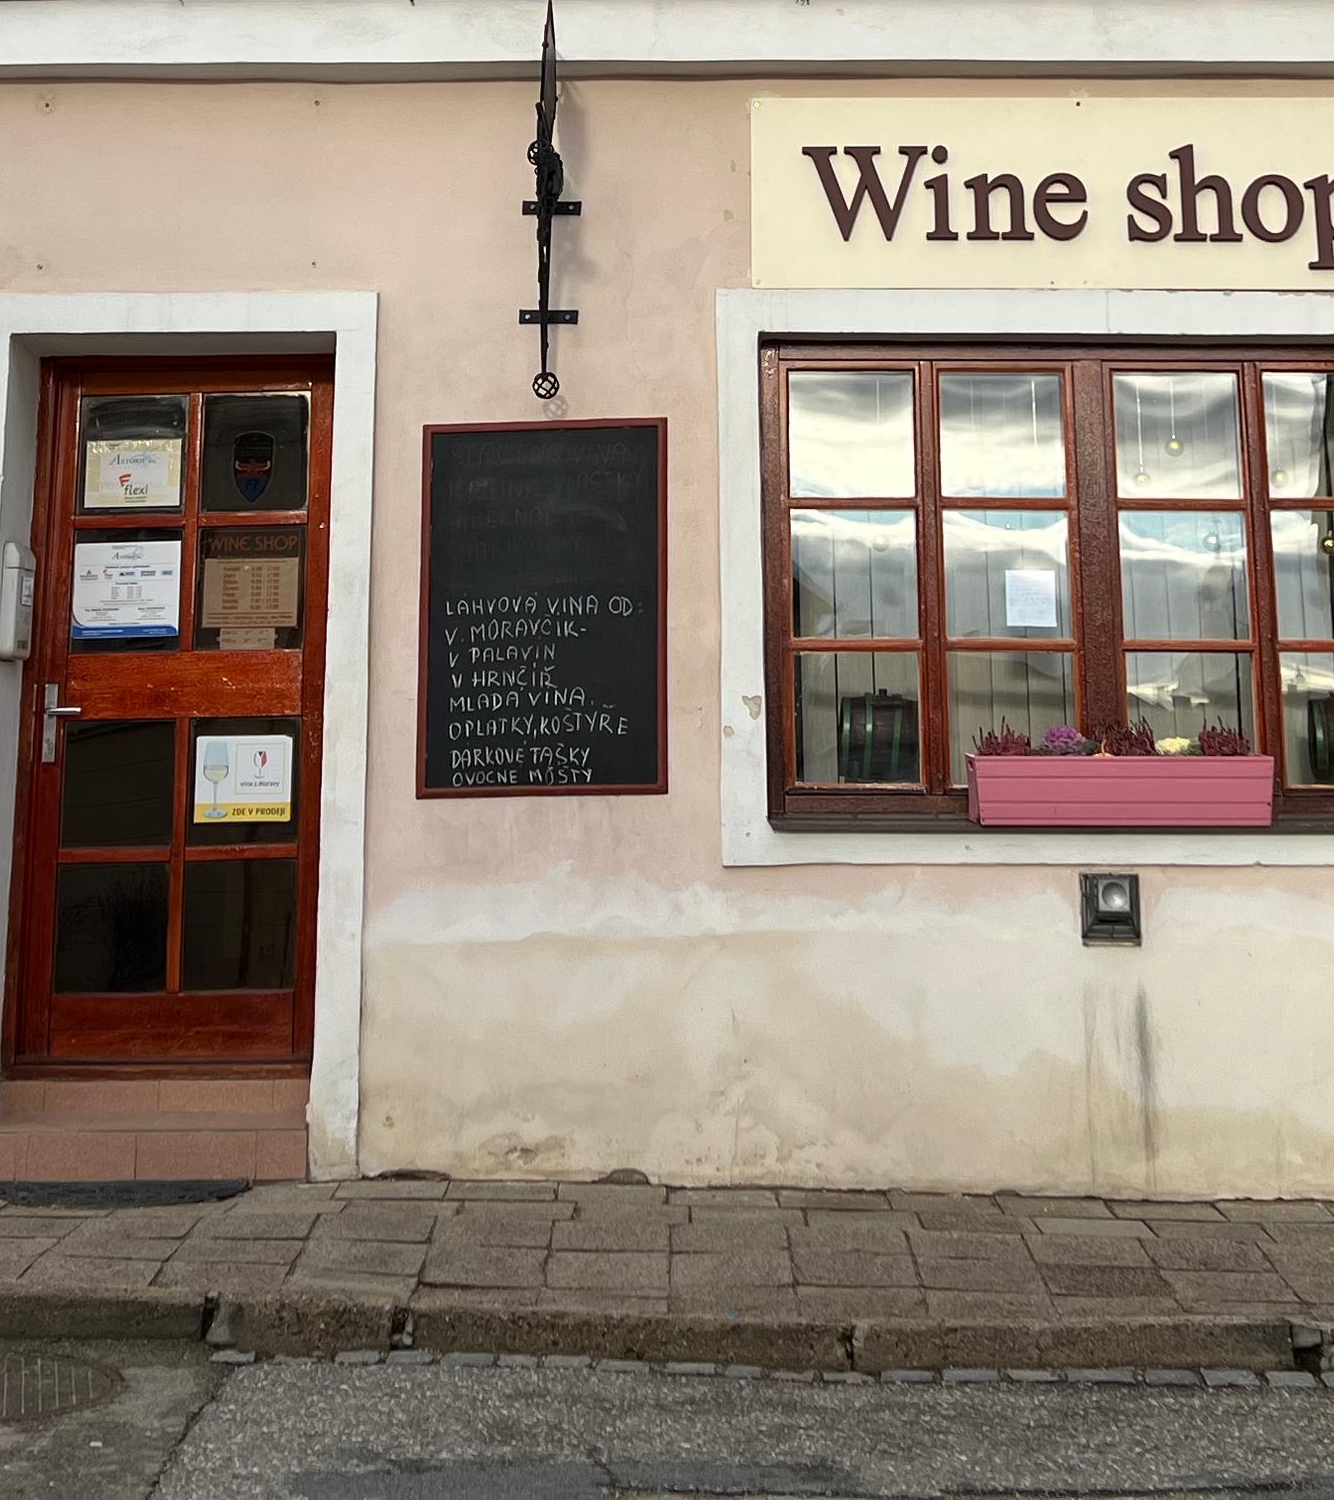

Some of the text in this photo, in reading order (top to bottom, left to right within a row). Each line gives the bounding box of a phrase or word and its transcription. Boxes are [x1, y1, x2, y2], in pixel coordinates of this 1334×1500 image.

[802, 144, 1088, 242] Wine
[124, 484, 149, 496] flexi
[208, 535, 298, 551] WINE SHOP
[449, 652, 460, 668] V
[452, 673, 463, 689] V
[530, 742, 591, 766] TAŠKY
[232, 808, 285, 816] ZDE V PRODEJI
